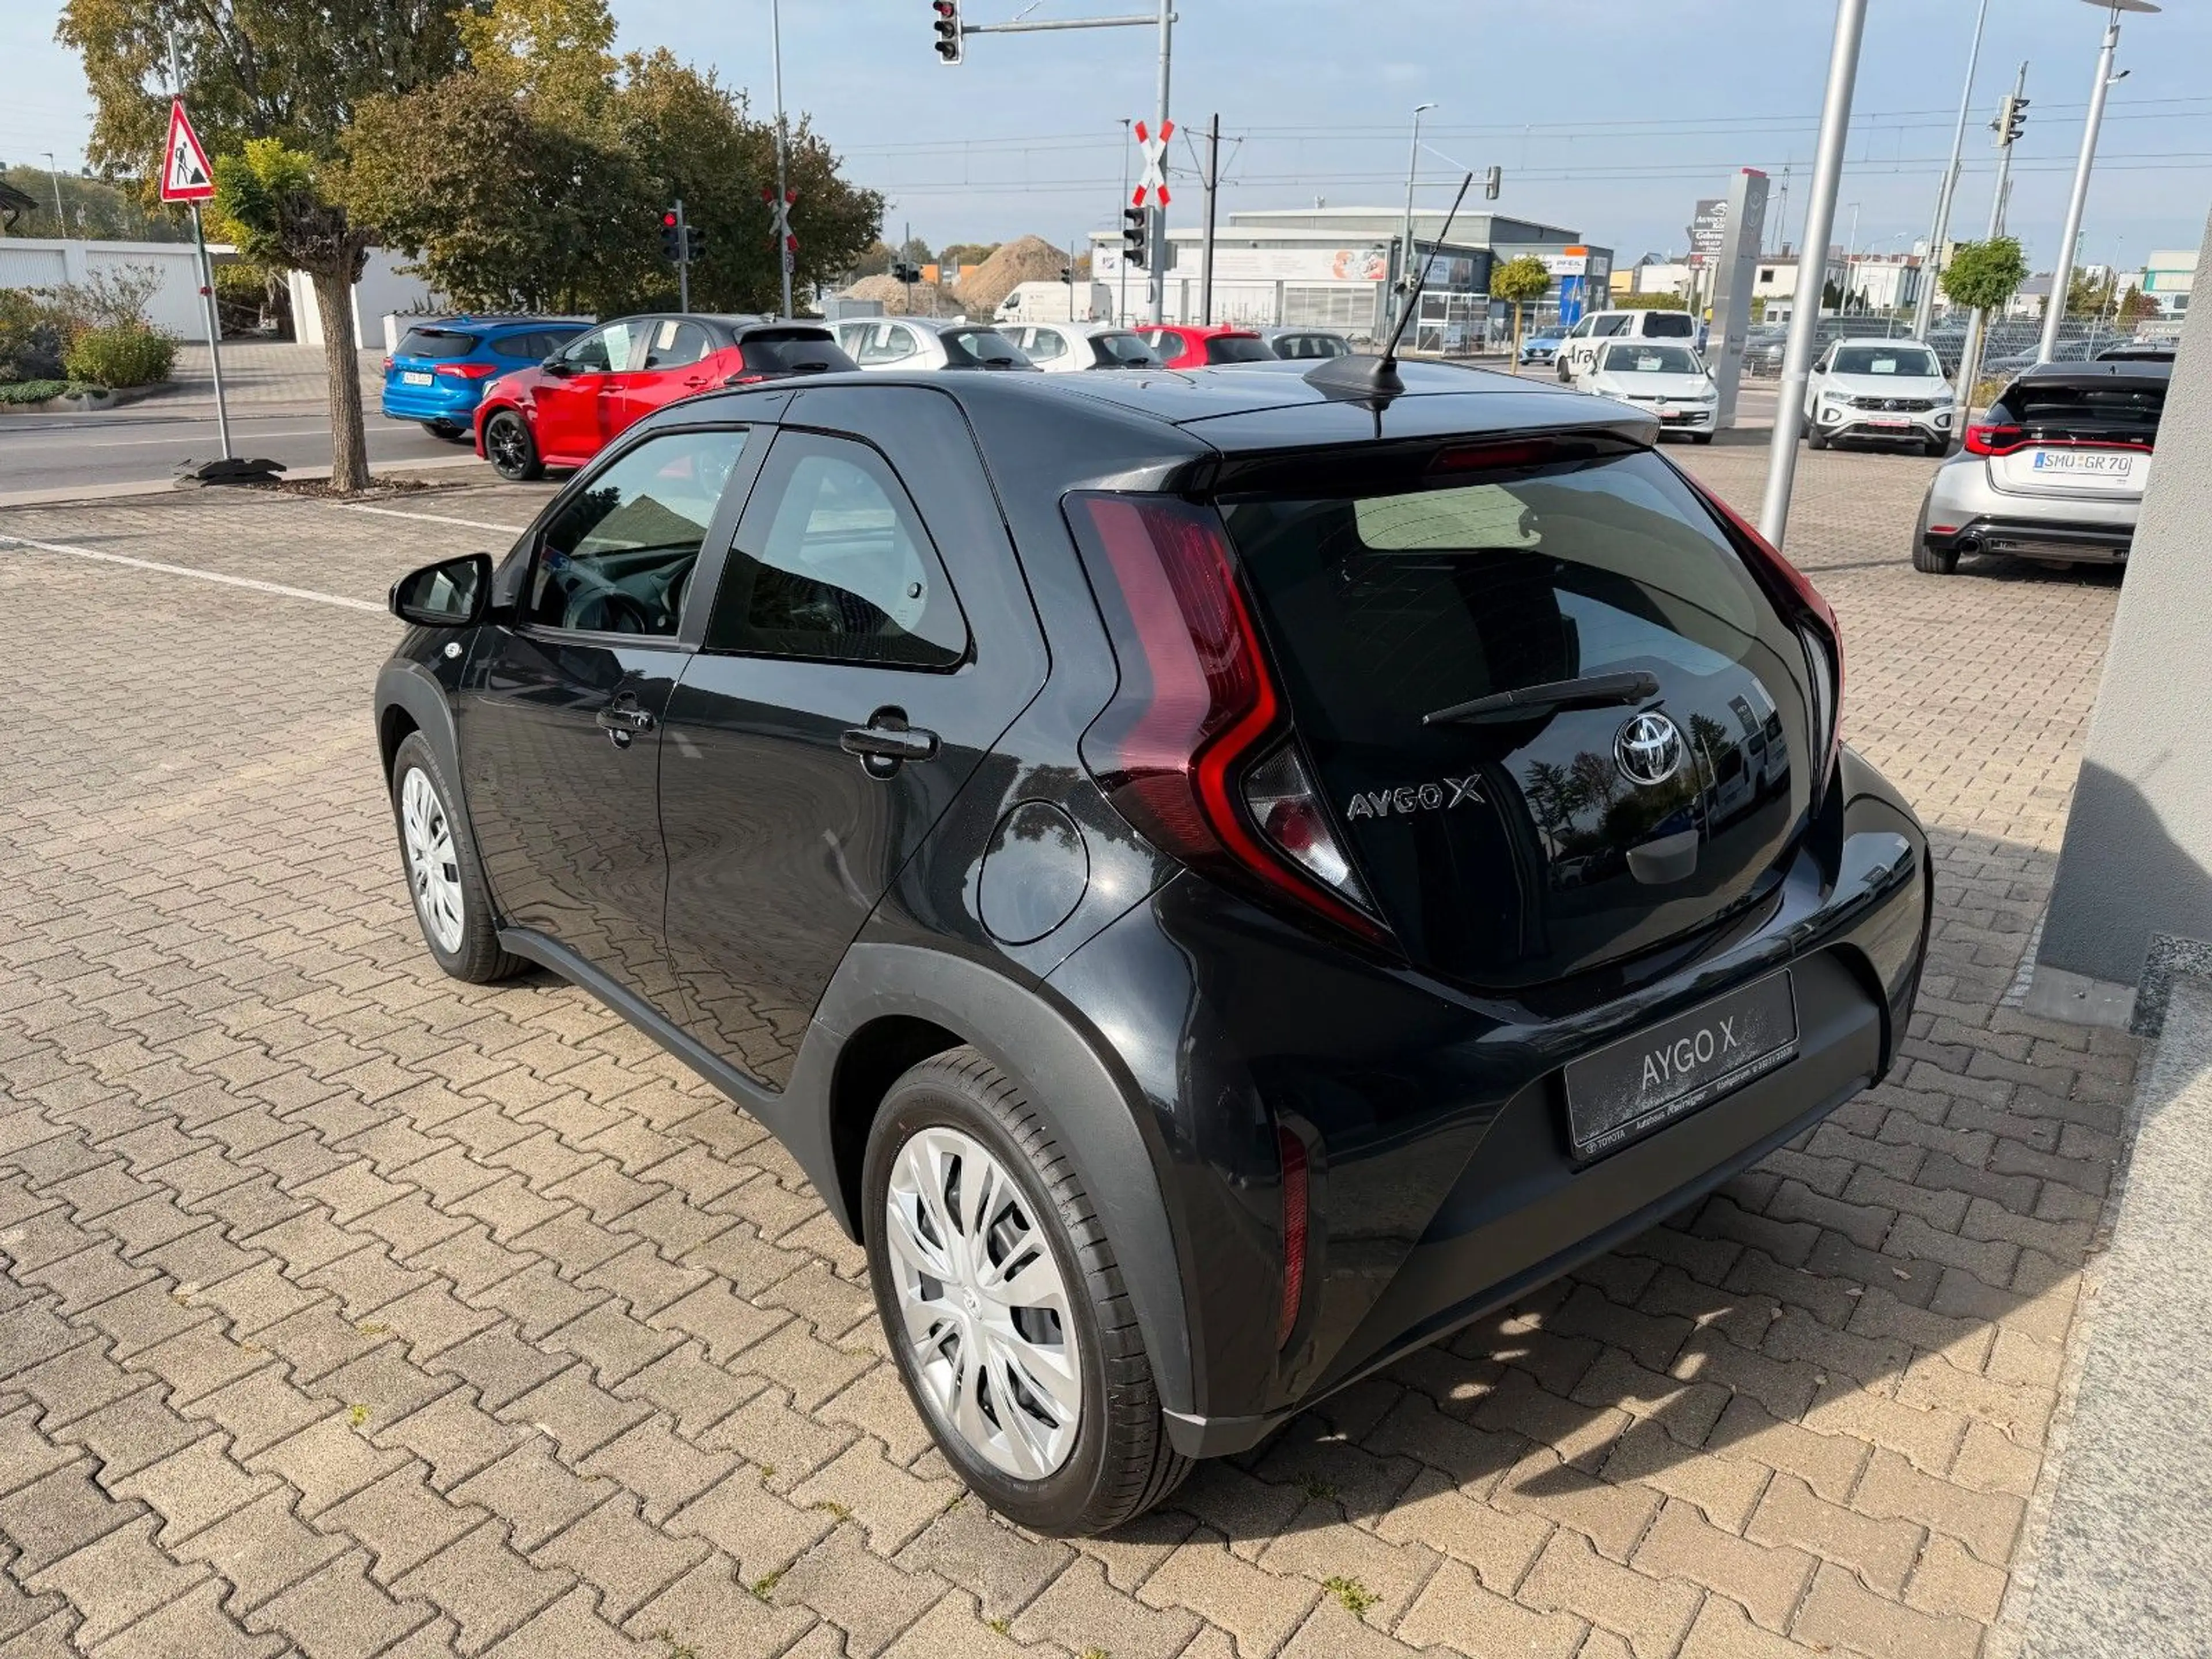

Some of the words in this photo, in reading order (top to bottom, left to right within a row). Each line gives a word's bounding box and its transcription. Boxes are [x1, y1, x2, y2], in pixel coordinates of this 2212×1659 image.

[2084, 456, 2105, 469] GR
[2109, 457, 2129, 471] 70
[1346, 783, 1443, 821] AYGO
[1443, 774, 1486, 809] X
[1642, 1029, 1714, 1090] AYGO
[1719, 1016, 1737, 1053] X
[1597, 1130, 1626, 1149] TOYOTA
